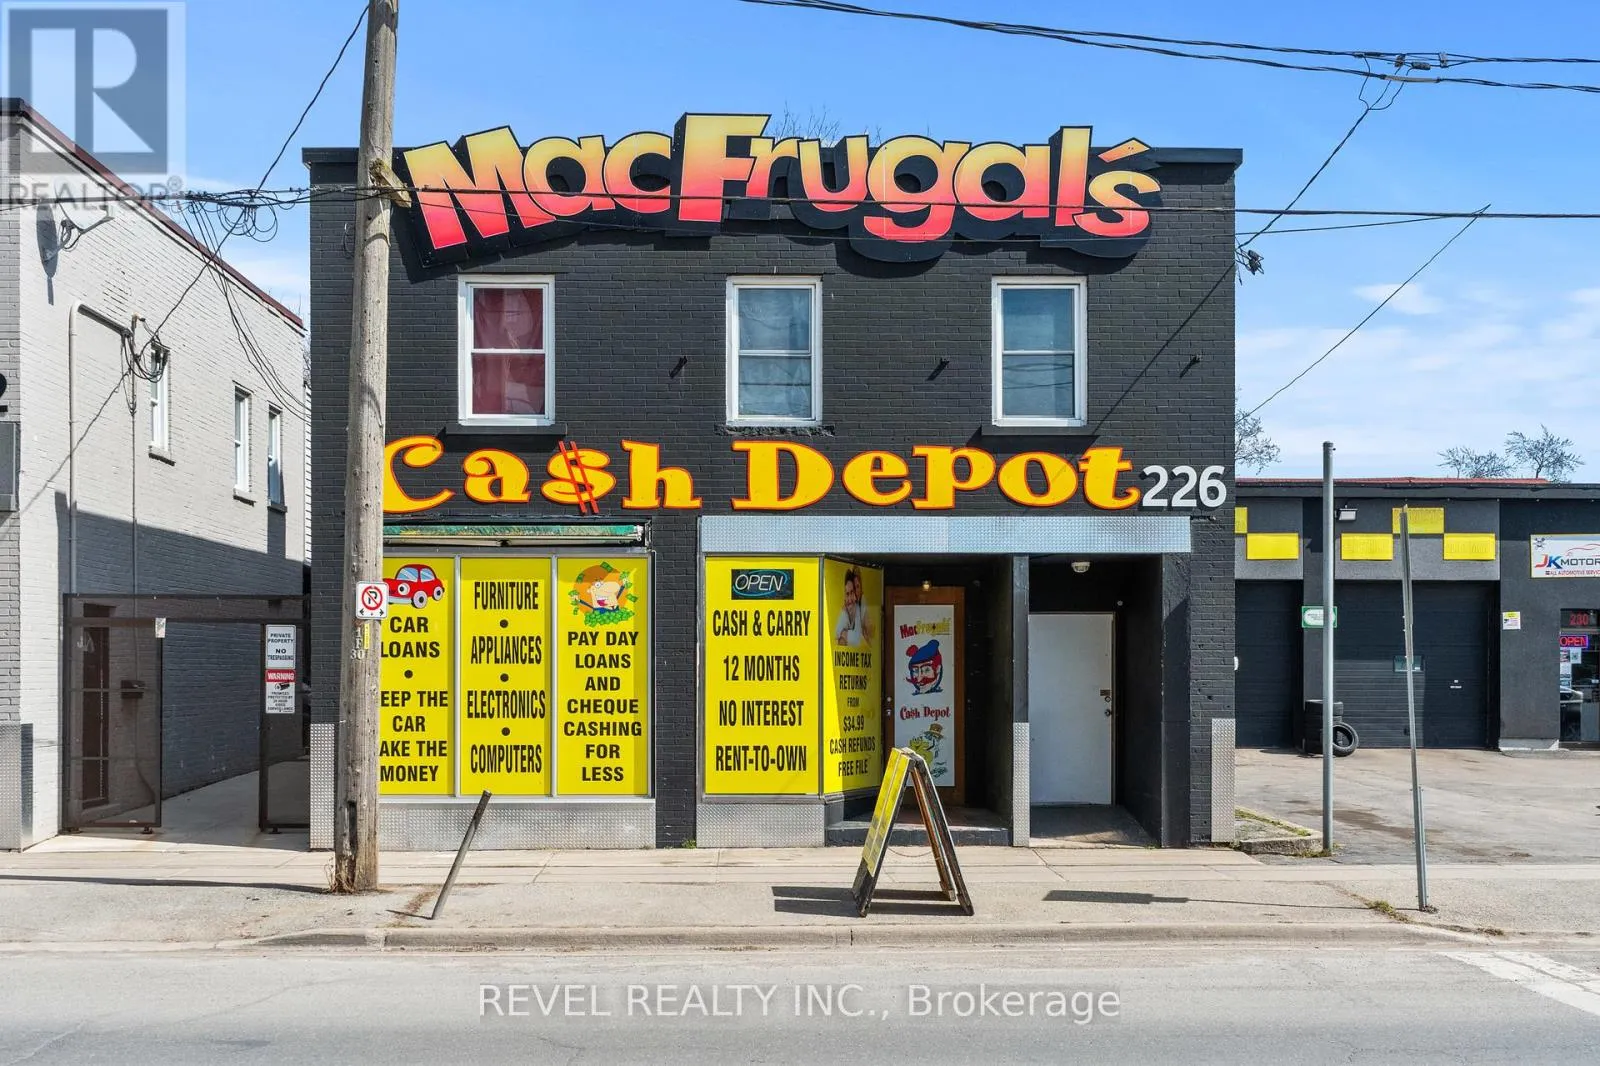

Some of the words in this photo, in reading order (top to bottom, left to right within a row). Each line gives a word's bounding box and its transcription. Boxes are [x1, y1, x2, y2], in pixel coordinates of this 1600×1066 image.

[403, 112, 1161, 250] MacFrugal's
[731, 440, 1141, 510] Depot
[1141, 465, 1227, 507] 226
[1535, 554, 1562, 569] JK
[735, 574, 784, 591] OPEN
[475, 582, 538, 610] FURNITURE
[390, 617, 428, 633] CAR
[713, 610, 747, 636] CASH
[753, 610, 761, 636] &
[767, 610, 810, 636] CARRY
[568, 632, 599, 645] PAY
[606, 631, 638, 645] DAY
[1560, 636, 1587, 646] OPEN
[381, 641, 439, 658] LOANS
[471, 636, 541, 664] APPLIANCES
[576, 654, 630, 668] LOANS
[724, 656, 739, 681] 12
[745, 655, 799, 681] MONTHS
[835, 652, 859, 667] INCOME
[861, 653, 871, 668] TAX
[268, 672, 294, 680] WARNING
[585, 677, 620, 691] AND
[840, 675, 867, 690] RETURNS
[381, 691, 410, 707] EEP
[417, 691, 448, 707] THE
[468, 690, 545, 719] ELECTRONICS
[568, 699, 638, 715] CHEQUE
[847, 697, 859, 707] FROM
[720, 700, 736, 726] NO
[742, 700, 804, 726] INTEREST
[923, 706, 951, 721] Depot
[393, 716, 425, 732] CAR
[564, 721, 641, 736] CASHING
[844, 716, 864, 732] $34.99
[380, 741, 410, 756] AKE
[416, 741, 447, 756] THE
[586, 744, 620, 758] FOR
[830, 738, 846, 754] CASH
[849, 736, 875, 753] REFUNDS
[471, 744, 541, 773] COMPUTERS
[716, 745, 806, 771] RENT-TO-OWN
[381, 765, 438, 781] MONEY
[583, 767, 623, 781] LESS
[839, 762, 853, 777] FREE
[856, 759, 867, 775] FILE
